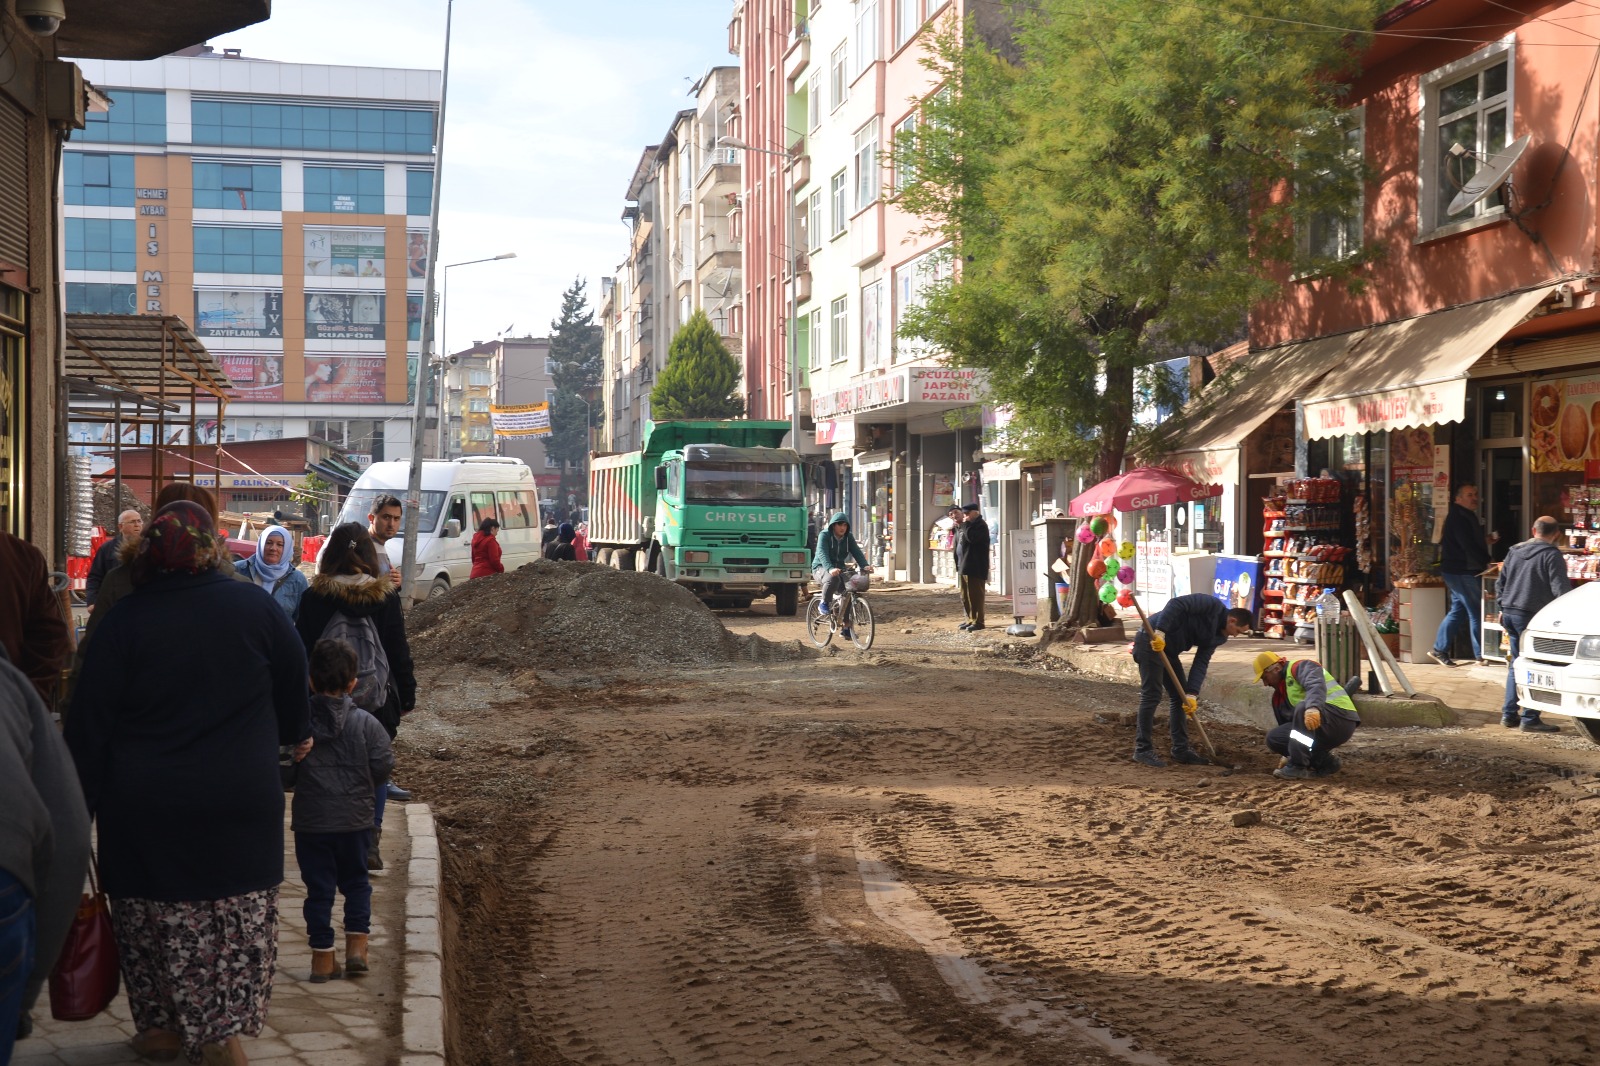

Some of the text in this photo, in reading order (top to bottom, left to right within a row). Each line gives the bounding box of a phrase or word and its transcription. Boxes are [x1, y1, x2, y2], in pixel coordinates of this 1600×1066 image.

[136, 188, 168, 199] MEHMET
[140, 205, 166, 216] AYBAR
[147, 223, 159, 256] İŞ
[210, 329, 260, 337] ZAYIFLAMA
[922, 392, 970, 400] PAZARI
[1320, 405, 1346, 429] YILMAZ
[1190, 485, 1211, 498] Golf
[1131, 493, 1159, 508] Golf
[1083, 501, 1103, 514] Golf
[705, 512, 787, 523] CHRYSLER
